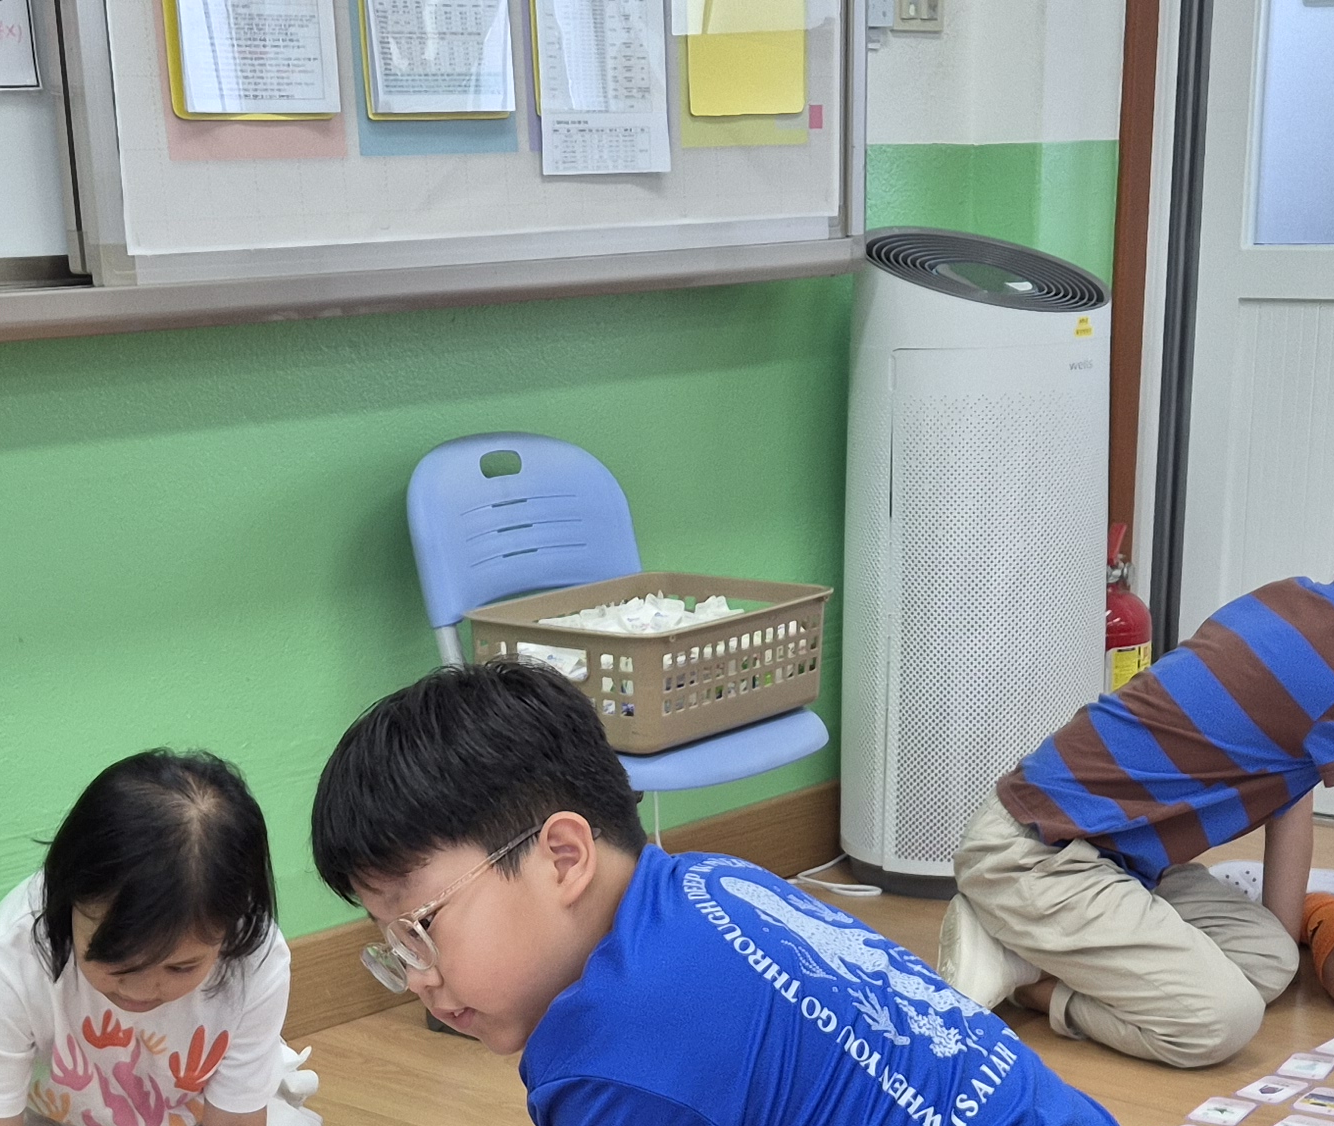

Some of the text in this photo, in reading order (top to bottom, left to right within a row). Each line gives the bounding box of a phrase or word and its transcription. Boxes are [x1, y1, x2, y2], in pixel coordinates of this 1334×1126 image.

[682, 873, 710, 902] DEEP
[695, 899, 802, 1004] THROUGH
[801, 997, 838, 1034] GO
[836, 1025, 883, 1076] YOU
